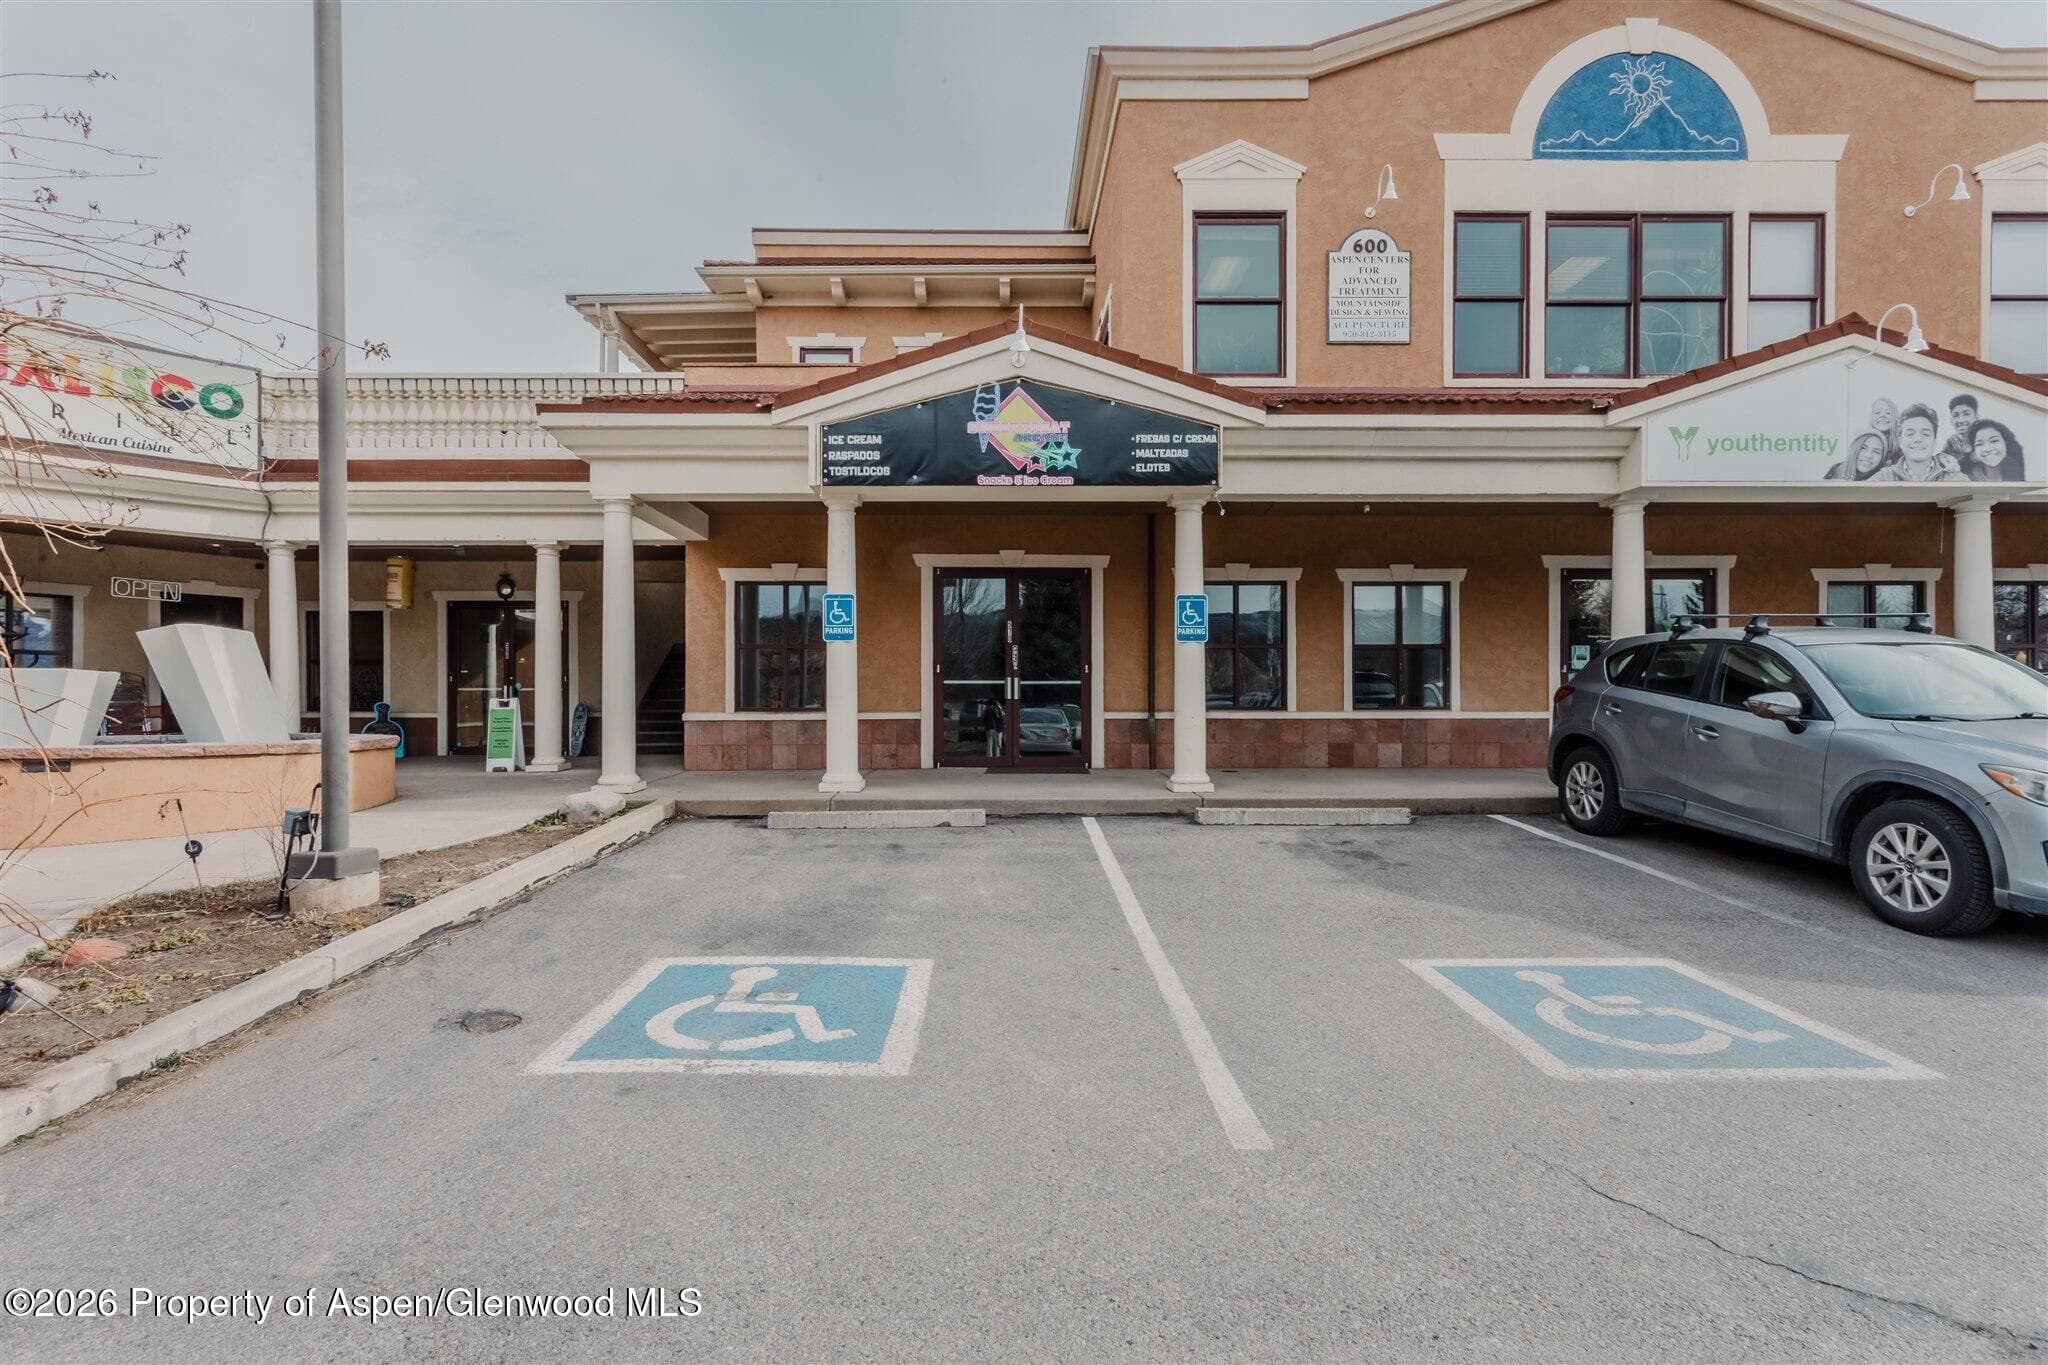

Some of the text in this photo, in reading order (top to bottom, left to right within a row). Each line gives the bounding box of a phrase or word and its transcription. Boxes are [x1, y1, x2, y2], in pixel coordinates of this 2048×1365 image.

[1353, 239, 1388, 253] 600
[1343, 277, 1397, 285] ADVANCED
[58, 426, 175, 454] Mexican Cuisine
[828, 435, 882, 445] ICE CREAM
[1136, 434, 1170, 444] FRESAS
[1185, 434, 1217, 444] CREMA
[1707, 432, 1839, 456] youthentity
[828, 451, 880, 461] RASPADOS
[1136, 449, 1189, 458] MALTEADAS
[829, 466, 891, 476] TOSTILOCOS
[1136, 463, 1170, 472] ELOTES
[977, 474, 1013, 486] Snacks
[1014, 475, 1023, 485] &
[1040, 474, 1074, 486] Cream
[115, 579, 178, 600] OPEN
[825, 627, 853, 635] PARKING
[1177, 627, 1206, 635] PARKING
